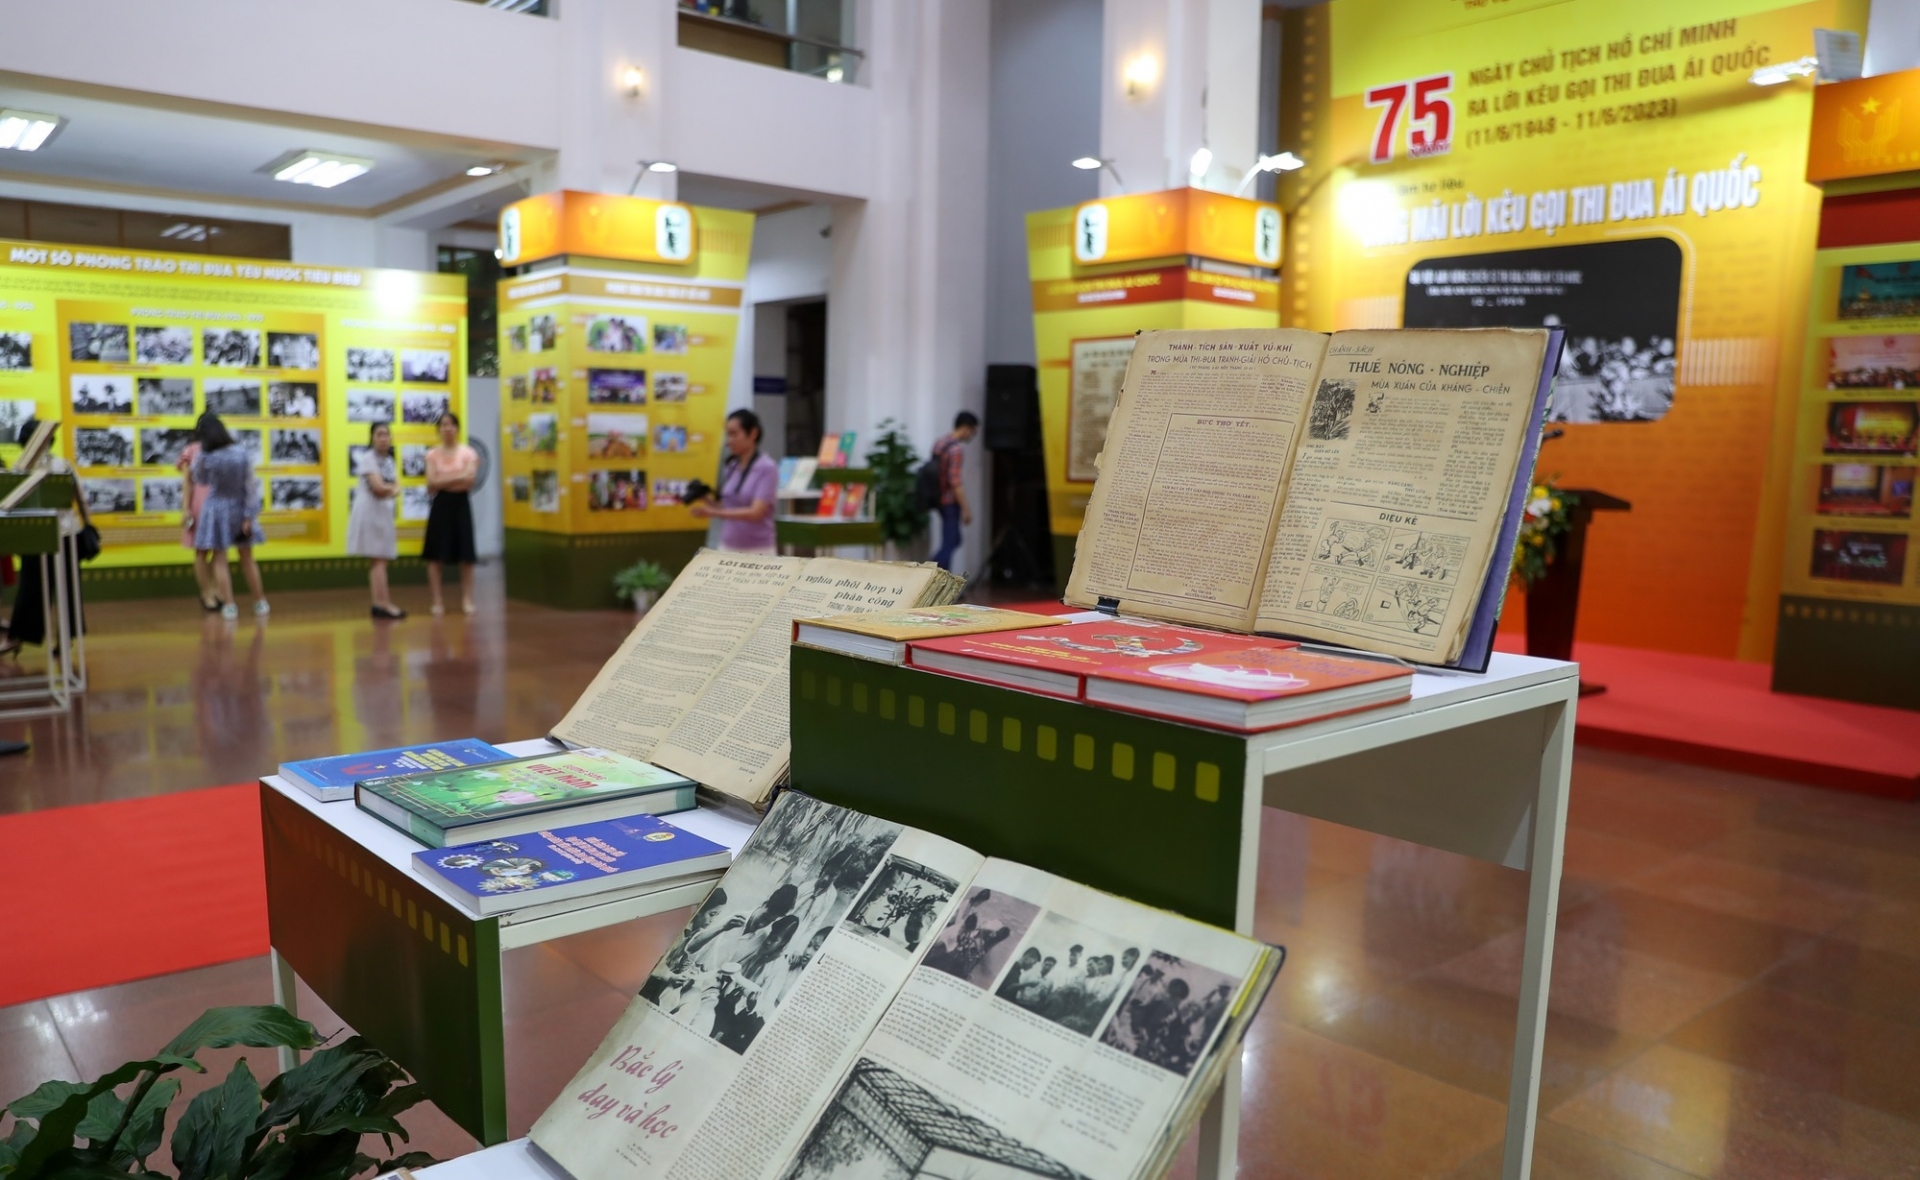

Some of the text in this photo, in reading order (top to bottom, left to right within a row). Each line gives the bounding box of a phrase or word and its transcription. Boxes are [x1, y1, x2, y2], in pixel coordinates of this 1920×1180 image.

[1639, 27, 1672, 55] CHÍ
[1679, 18, 1737, 48] MINH
[1602, 71, 1631, 95] THI
[1683, 54, 1704, 81] ÁI
[1711, 41, 1771, 76] QUỐC
[1365, 72, 1453, 163] 75
[1530, 188, 1567, 236] GỌI
[1570, 184, 1606, 225] THI
[1609, 178, 1655, 222] ĐUA
[1659, 168, 1688, 216] ÁI
[1690, 153, 1761, 217] QUỐC
[1148, 355, 1171, 363] TRONG
[1349, 358, 1381, 373] THUẾ
[1388, 360, 1424, 375] NÔNG
[1439, 362, 1490, 379] NGHIỆP
[1441, 382, 1472, 393] KHÁNG
[834, 590, 896, 609] phân công
[864, 582, 887, 594] hợp
[891, 585, 904, 596] và
[554, 774, 599, 789] NAM
[609, 1044, 656, 1078] Bắc
[577, 1082, 679, 1140] dạy và học
